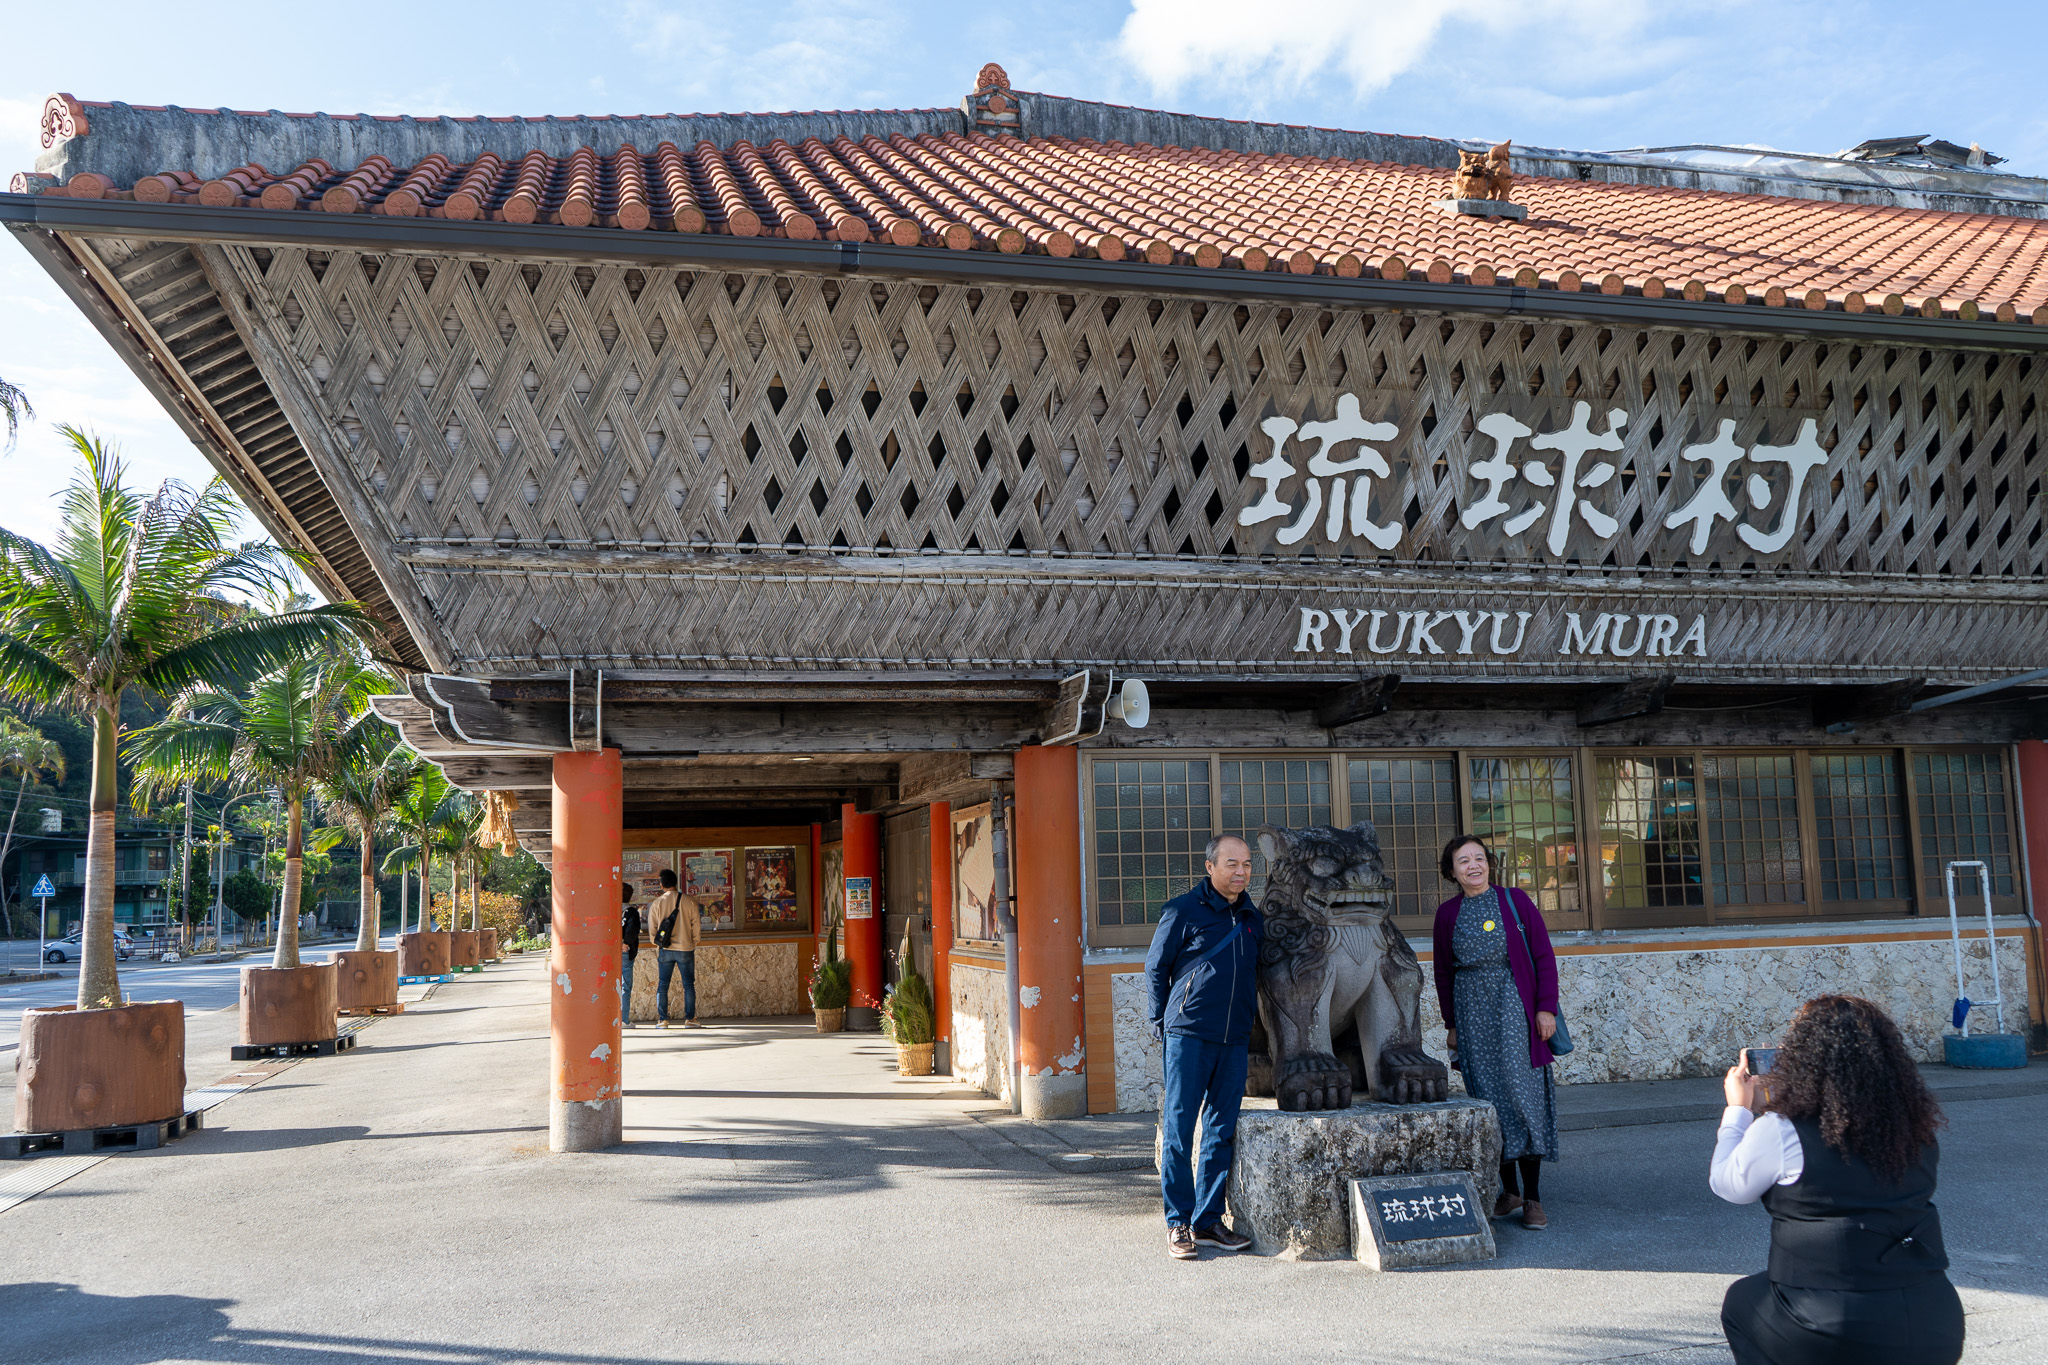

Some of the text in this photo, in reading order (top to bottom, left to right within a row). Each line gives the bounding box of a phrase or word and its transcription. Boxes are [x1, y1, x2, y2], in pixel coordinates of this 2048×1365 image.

[1238, 392, 1828, 557] 琉球村
[1293, 607, 1708, 657] RYUKYU MURA
[1382, 1193, 1466, 1223] 琉球村
